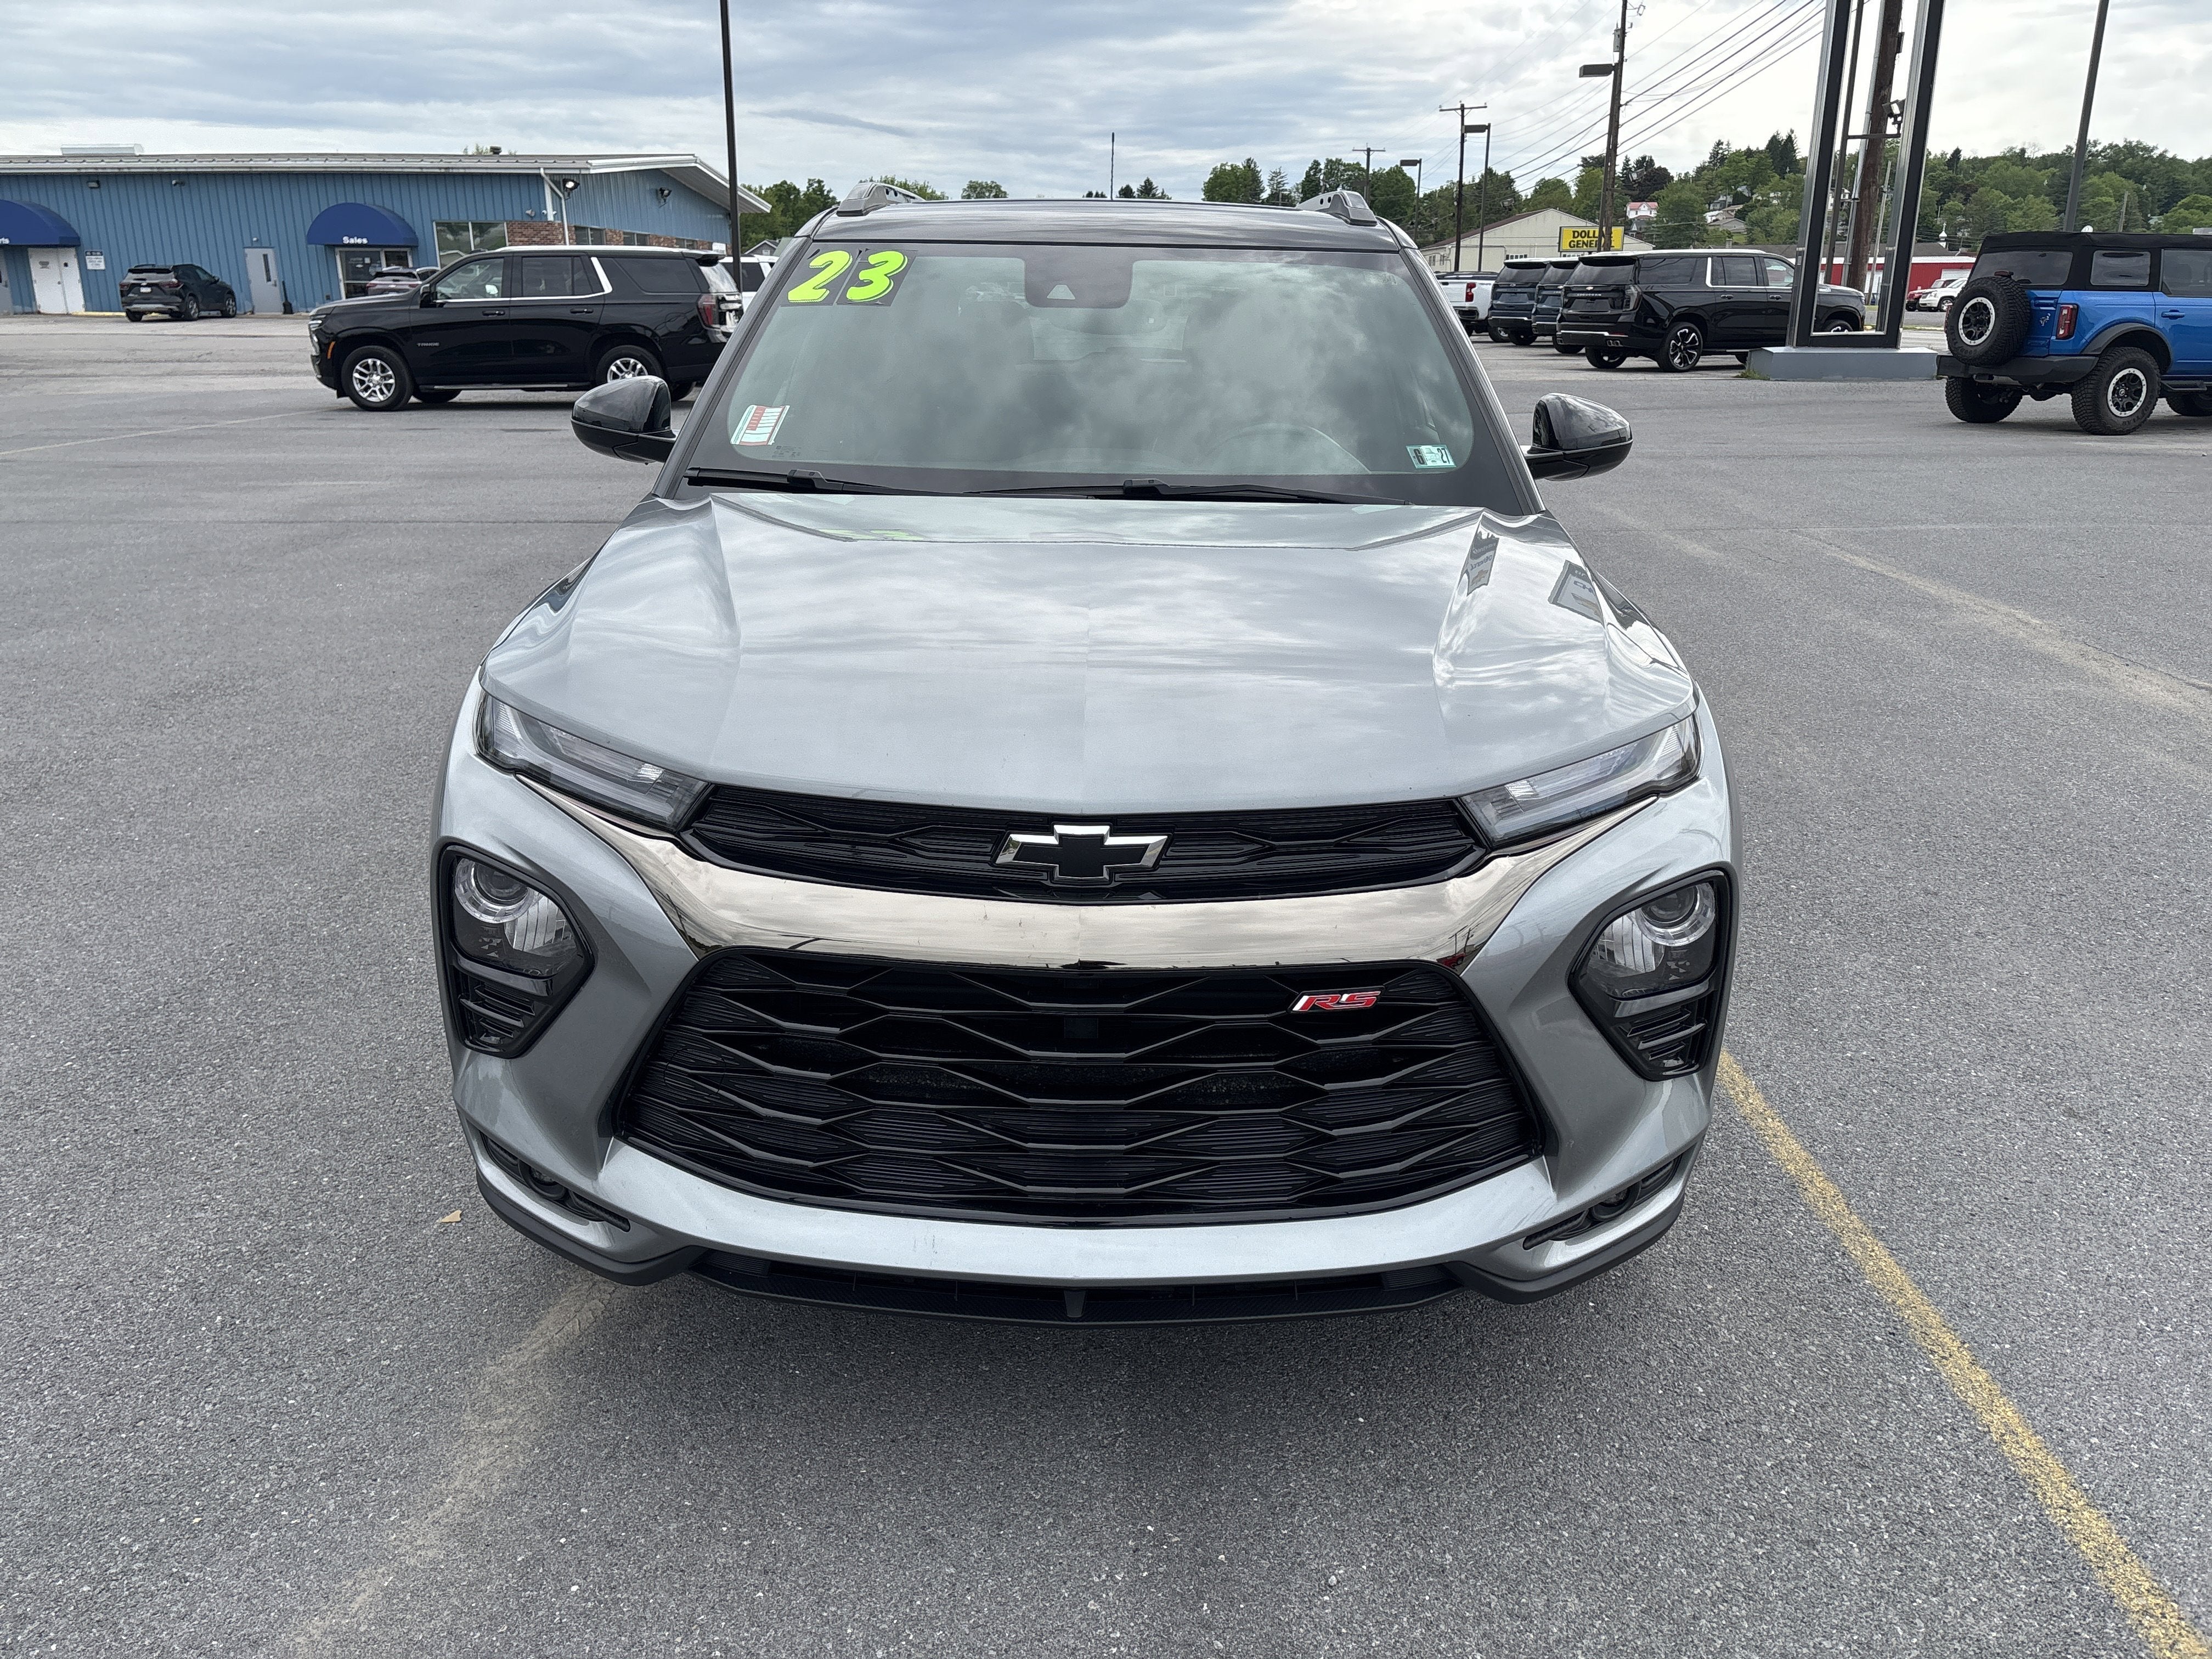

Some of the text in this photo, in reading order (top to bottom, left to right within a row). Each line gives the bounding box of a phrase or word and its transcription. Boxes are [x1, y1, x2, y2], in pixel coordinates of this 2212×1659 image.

[342, 236, 368, 244] Sales
[1572, 230, 1613, 239] DOLL
[788, 251, 908, 302] 23
[1437, 448, 1450, 464] 27
[1292, 991, 1381, 1012] RS
